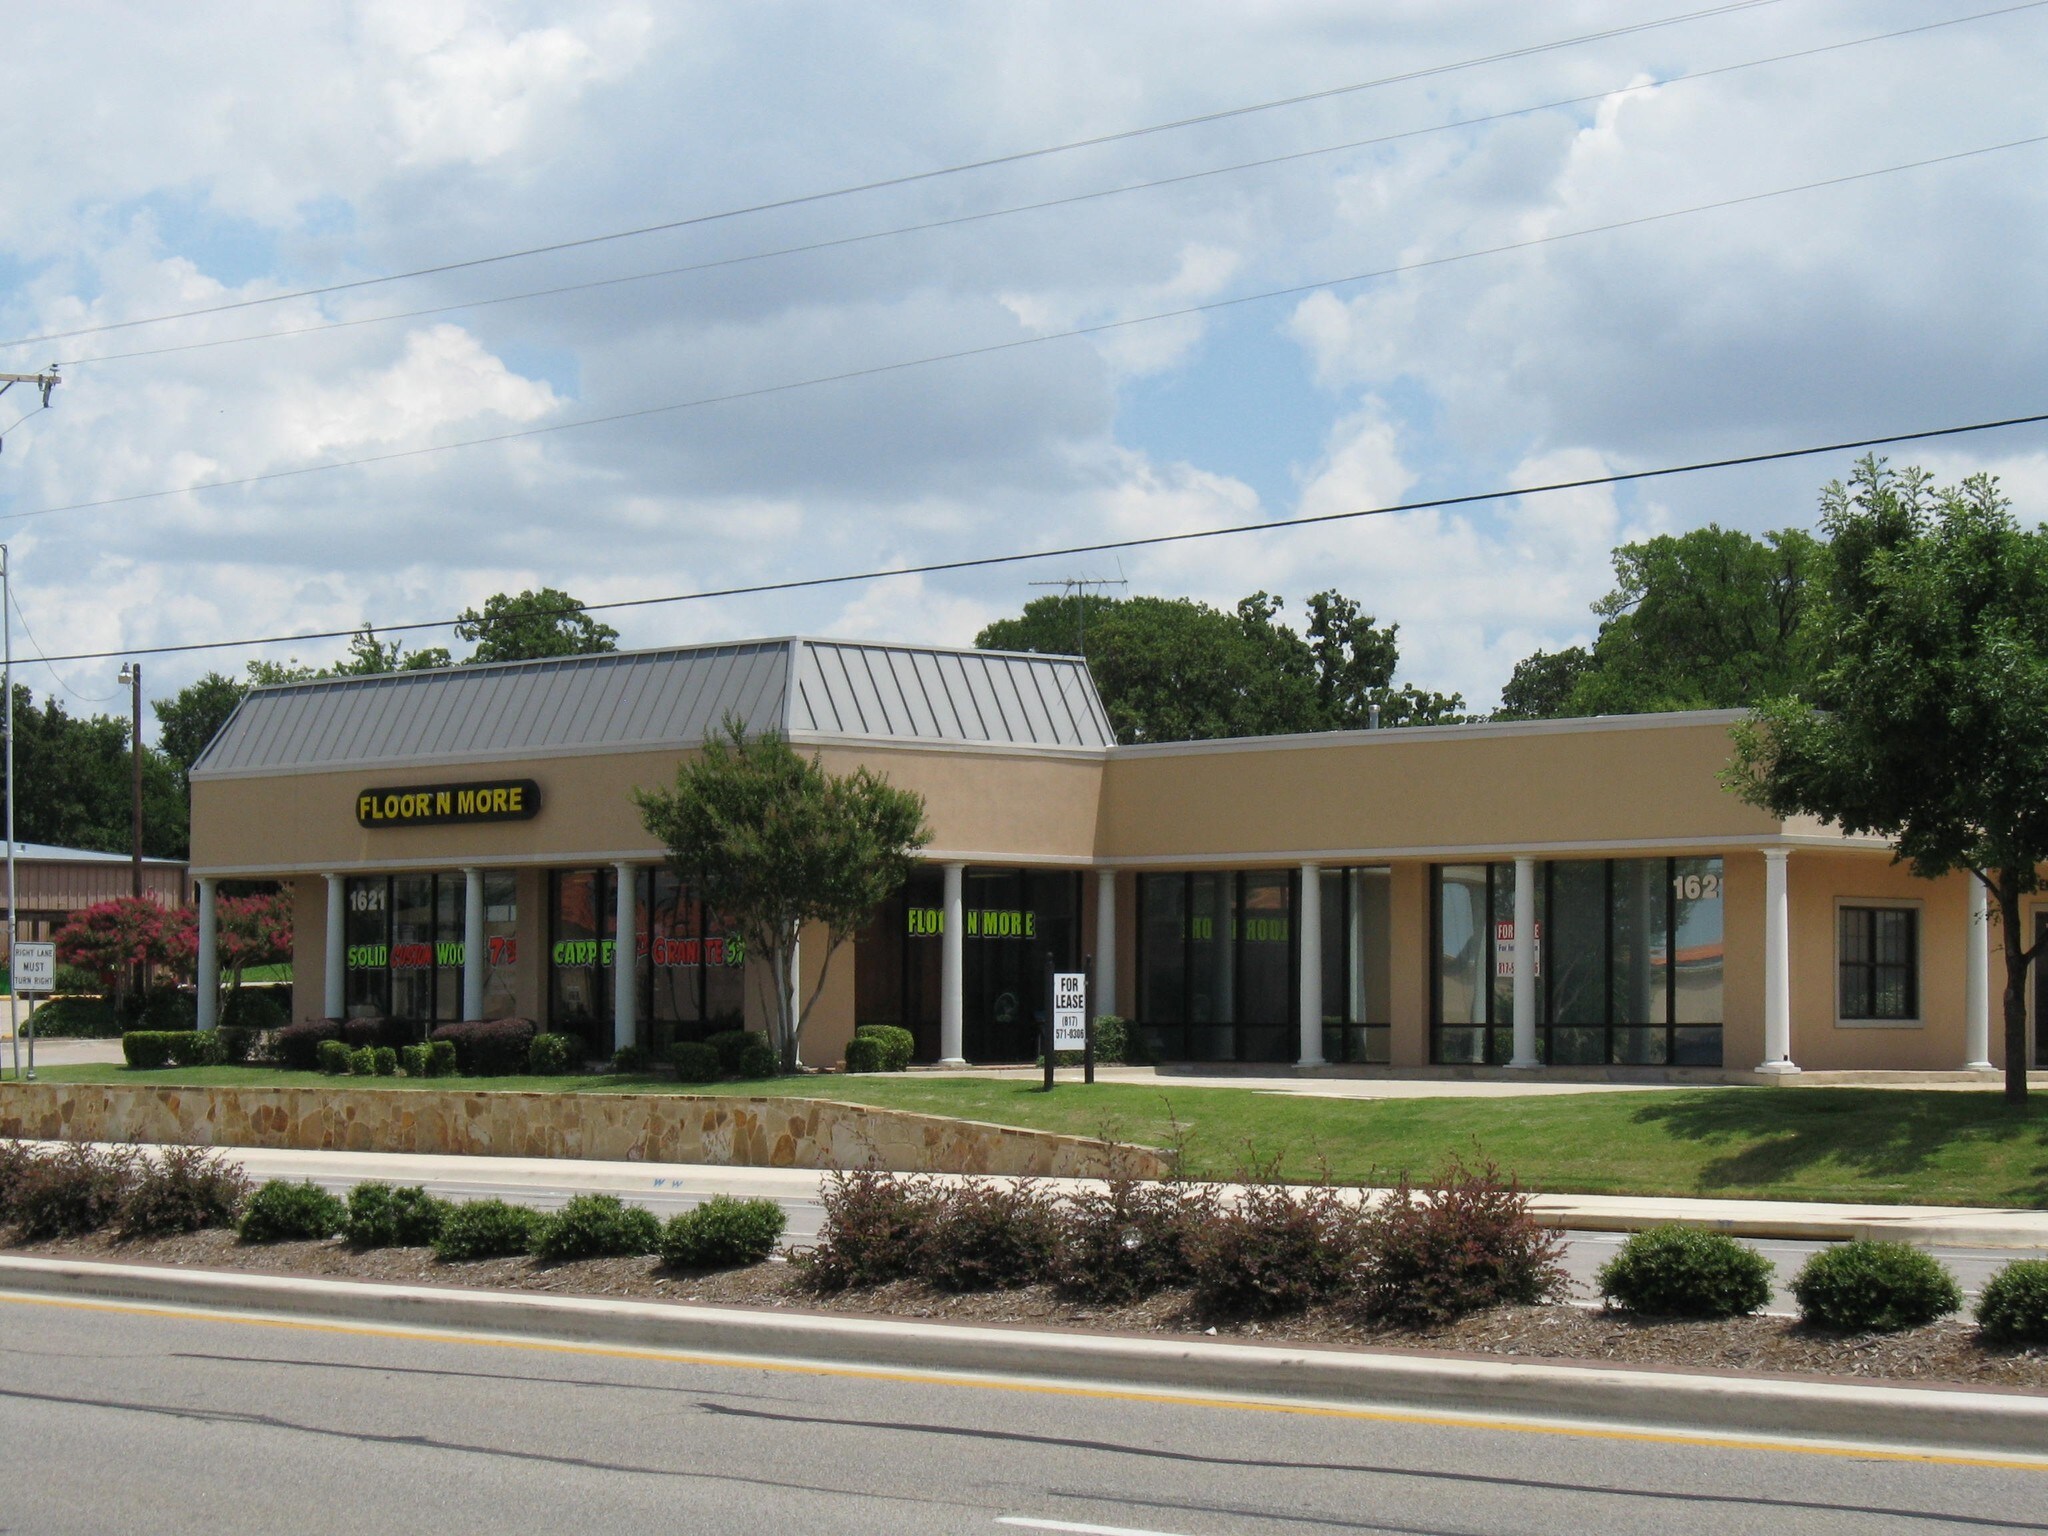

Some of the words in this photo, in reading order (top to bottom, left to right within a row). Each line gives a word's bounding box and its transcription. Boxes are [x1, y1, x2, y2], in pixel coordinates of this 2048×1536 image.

[360, 793, 430, 819] FLOOR
[436, 791, 450, 815] N
[458, 787, 522, 814] MORE
[350, 890, 385, 911] 1621
[908, 909, 945, 935] FLO
[967, 911, 978, 935] N
[983, 911, 1034, 936] MORE
[1498, 924, 1514, 939] FOR
[16, 949, 34, 957] RIGHT
[37, 949, 52, 957] LANE
[349, 945, 387, 967] SOLID
[436, 942, 465, 966] WOO
[24, 961, 44, 971] MUST
[1061, 978, 1078, 992] FOR
[1056, 995, 1083, 1008] LEASE
[1062, 1016, 1078, 1026] (817)
